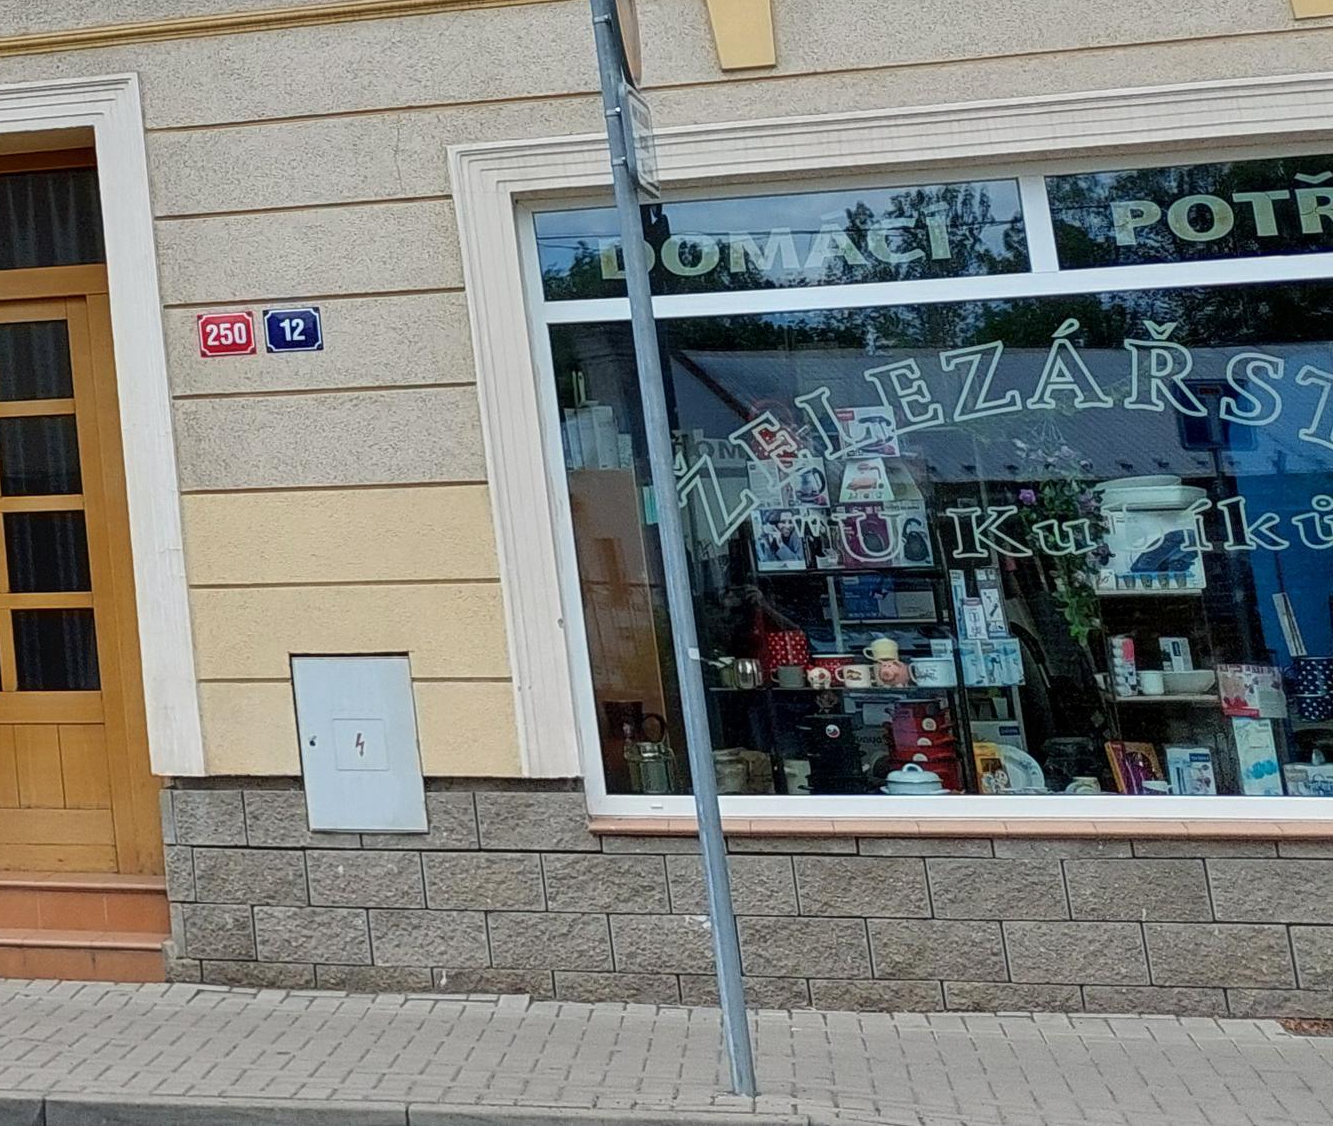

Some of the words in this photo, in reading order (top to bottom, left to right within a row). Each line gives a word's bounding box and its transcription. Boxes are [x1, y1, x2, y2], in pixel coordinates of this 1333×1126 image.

[599, 200, 951, 280] DOMÁCÍ
[205, 322, 247, 346] 250
[279, 318, 306, 341] 12
